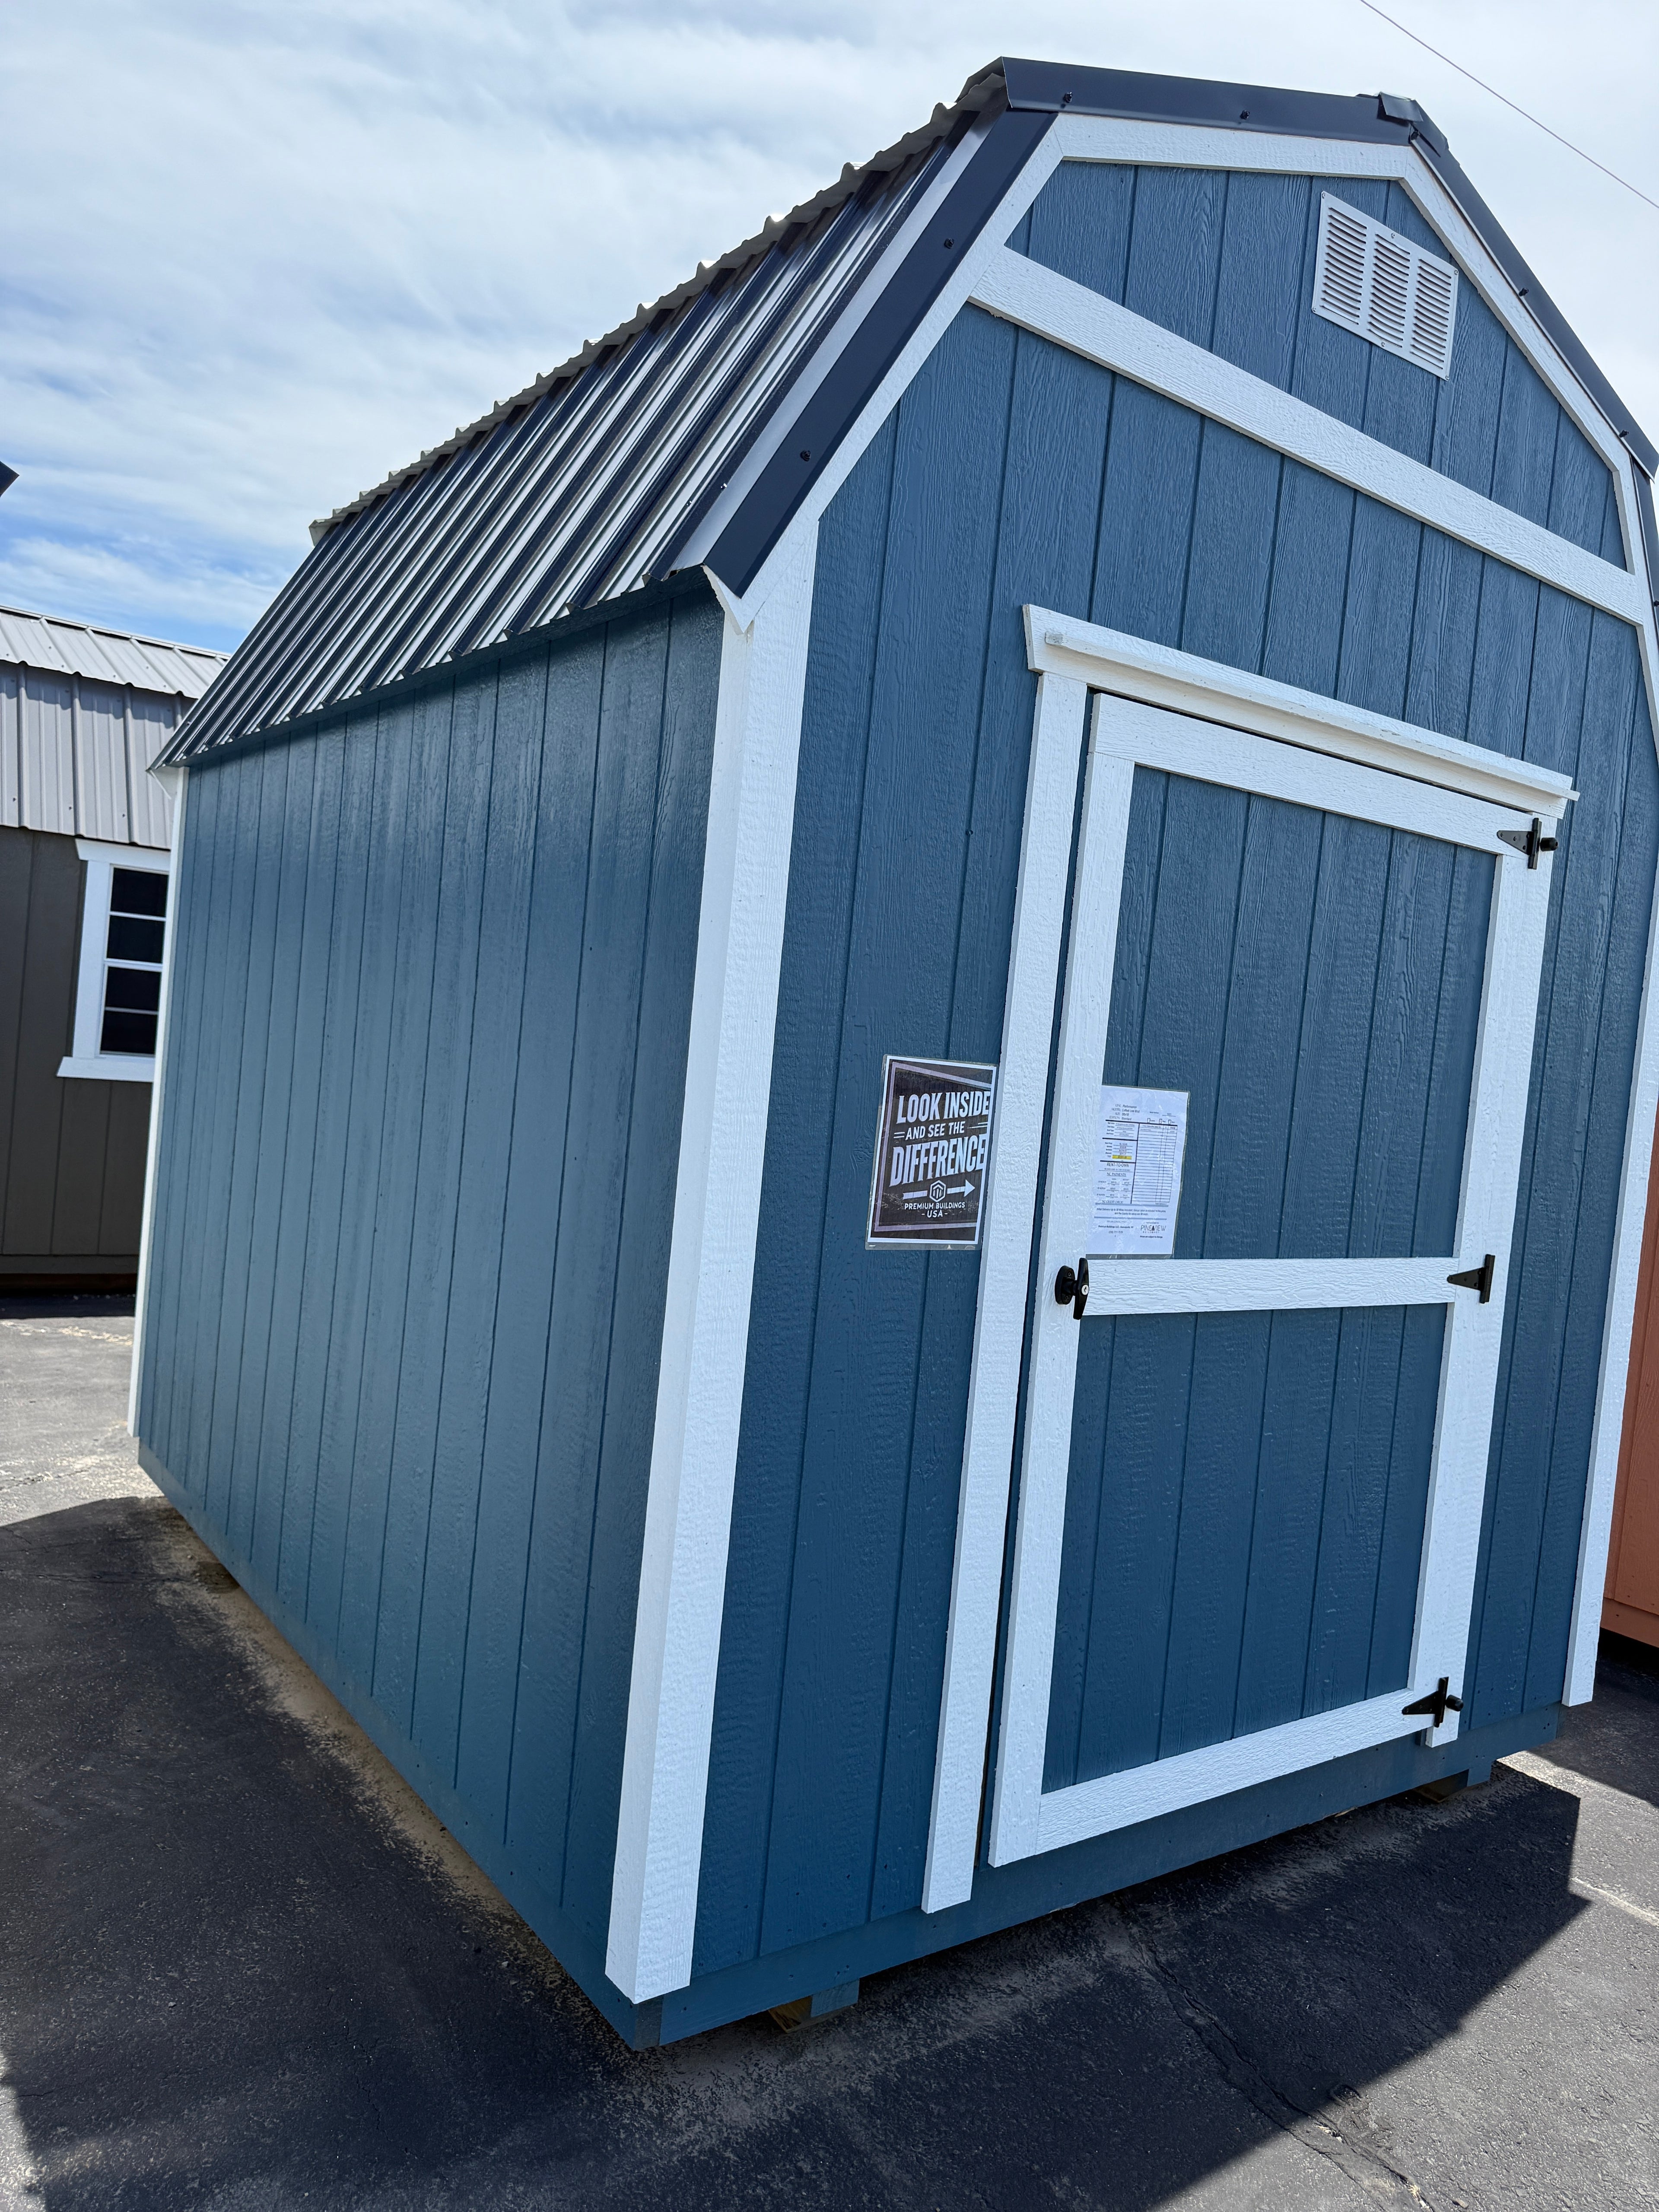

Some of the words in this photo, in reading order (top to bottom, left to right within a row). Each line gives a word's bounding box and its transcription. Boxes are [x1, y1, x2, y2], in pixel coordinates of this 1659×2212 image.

[896, 1092, 941, 1124] LOOK
[943, 1090, 991, 1120] INSIDE
[905, 1125, 925, 1141] AND
[928, 1123, 945, 1137] SEE
[949, 1121, 966, 1134] THE
[889, 1133, 986, 1187] DIFFERENCE
